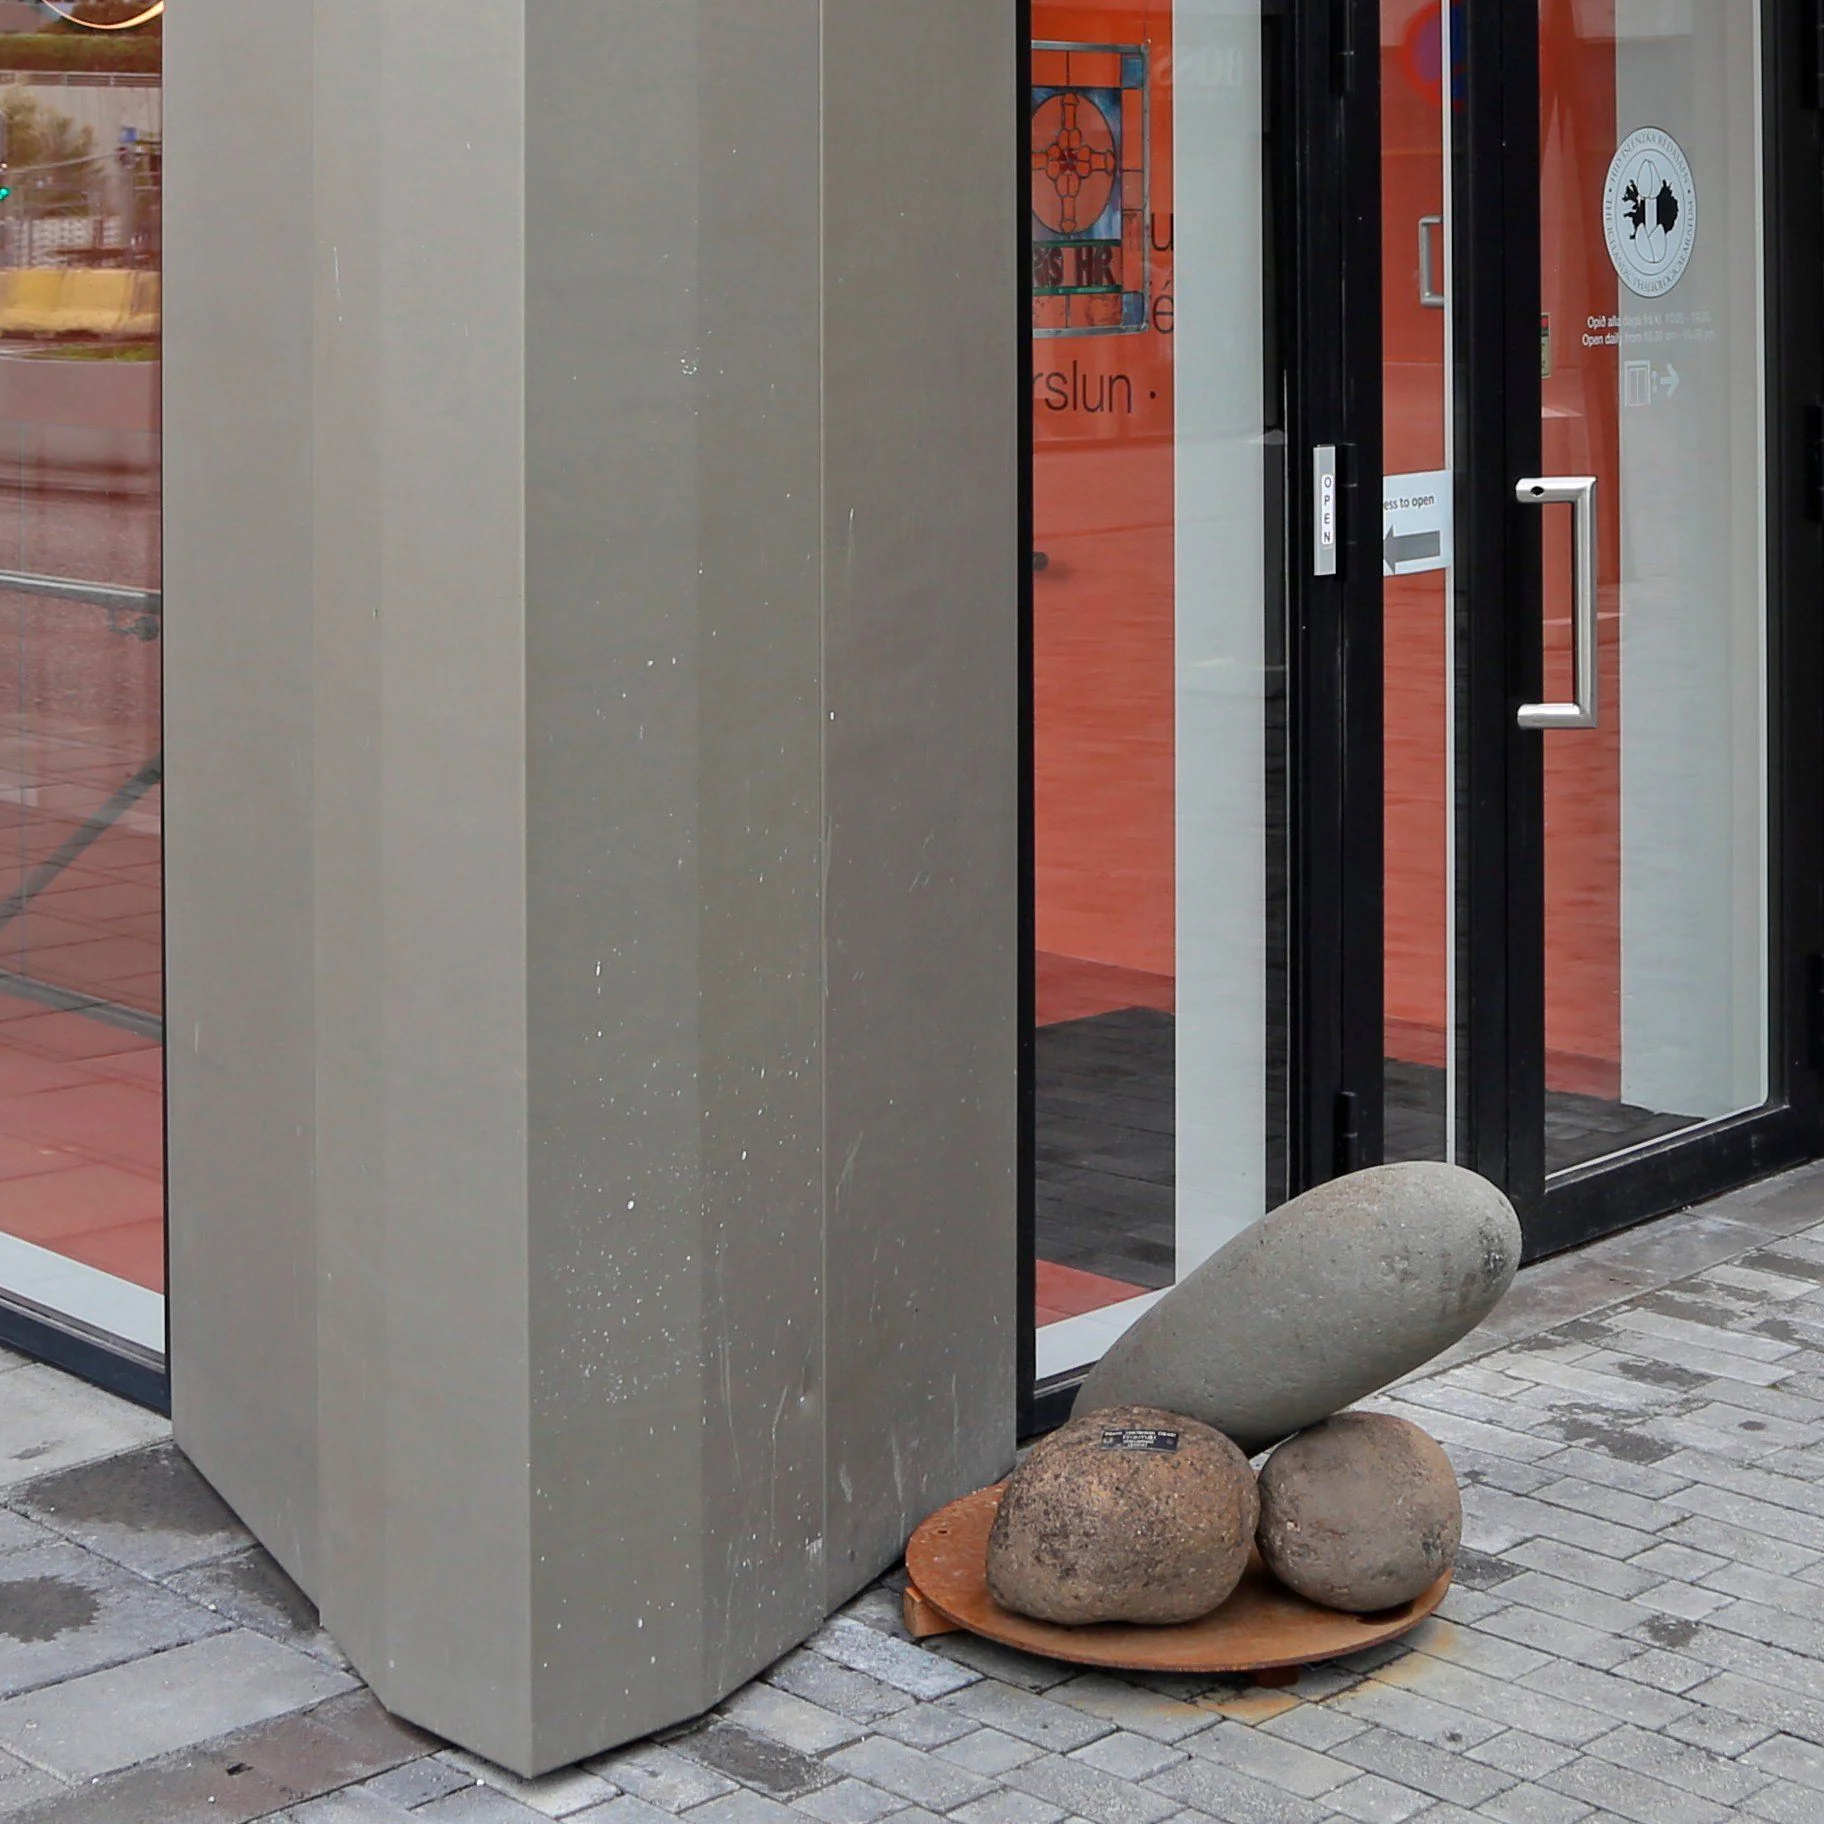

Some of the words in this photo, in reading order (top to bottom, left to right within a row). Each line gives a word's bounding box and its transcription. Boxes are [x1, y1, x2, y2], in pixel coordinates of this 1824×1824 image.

[1582, 333, 1604, 347] Open
[1400, 497, 1410, 508] to
[1411, 494, 1435, 508] open
[1323, 476, 1332, 543] OPEN
